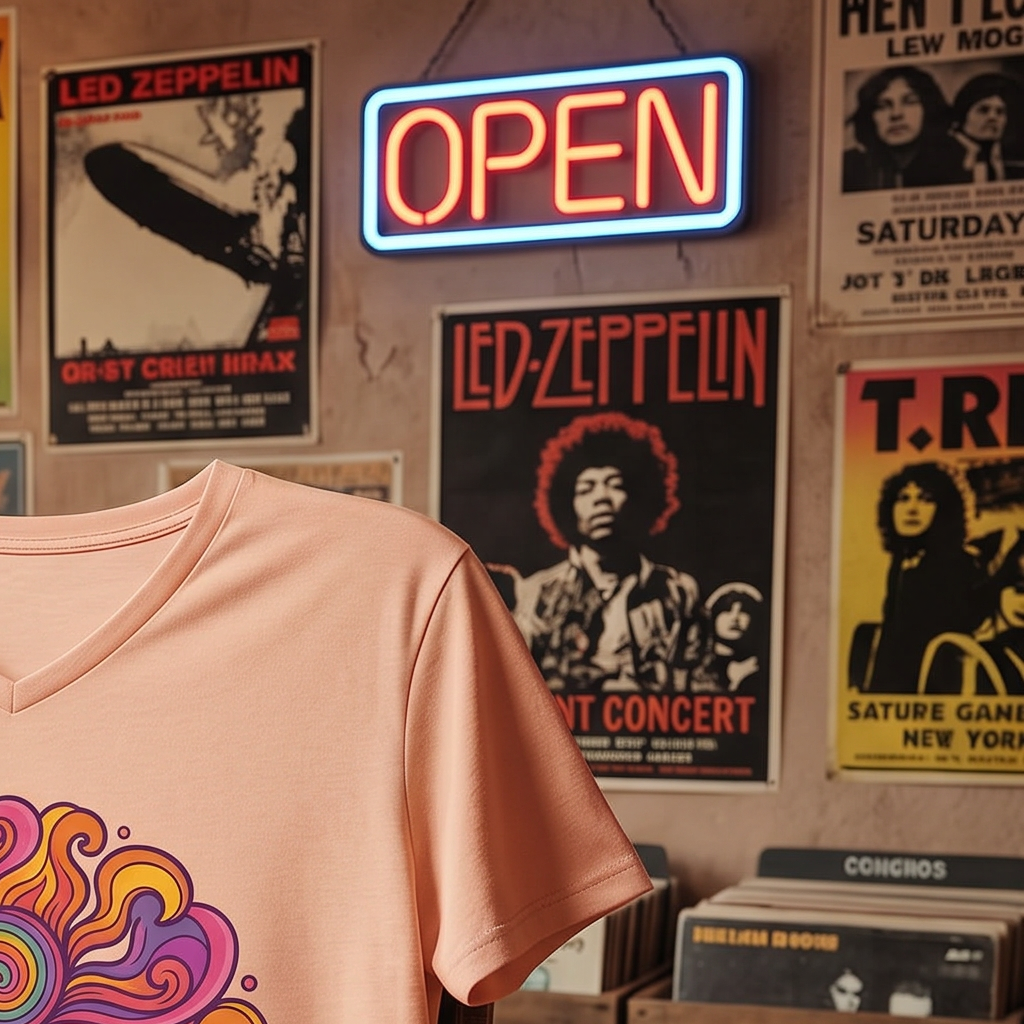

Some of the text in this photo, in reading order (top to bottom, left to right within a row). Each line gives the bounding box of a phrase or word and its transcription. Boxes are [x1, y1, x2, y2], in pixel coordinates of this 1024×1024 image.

[887, 32, 944, 58] LEW
[58, 55, 299, 107] LED ZEPPELIN
[384, 82, 719, 227] OPEN
[857, 211, 1024, 245] SATURDAY
[860, 374, 1024, 452] T.R
[603, 694, 756, 734] CONCERT
[848, 702, 945, 721] SATURE
[903, 729, 954, 748] NEW
